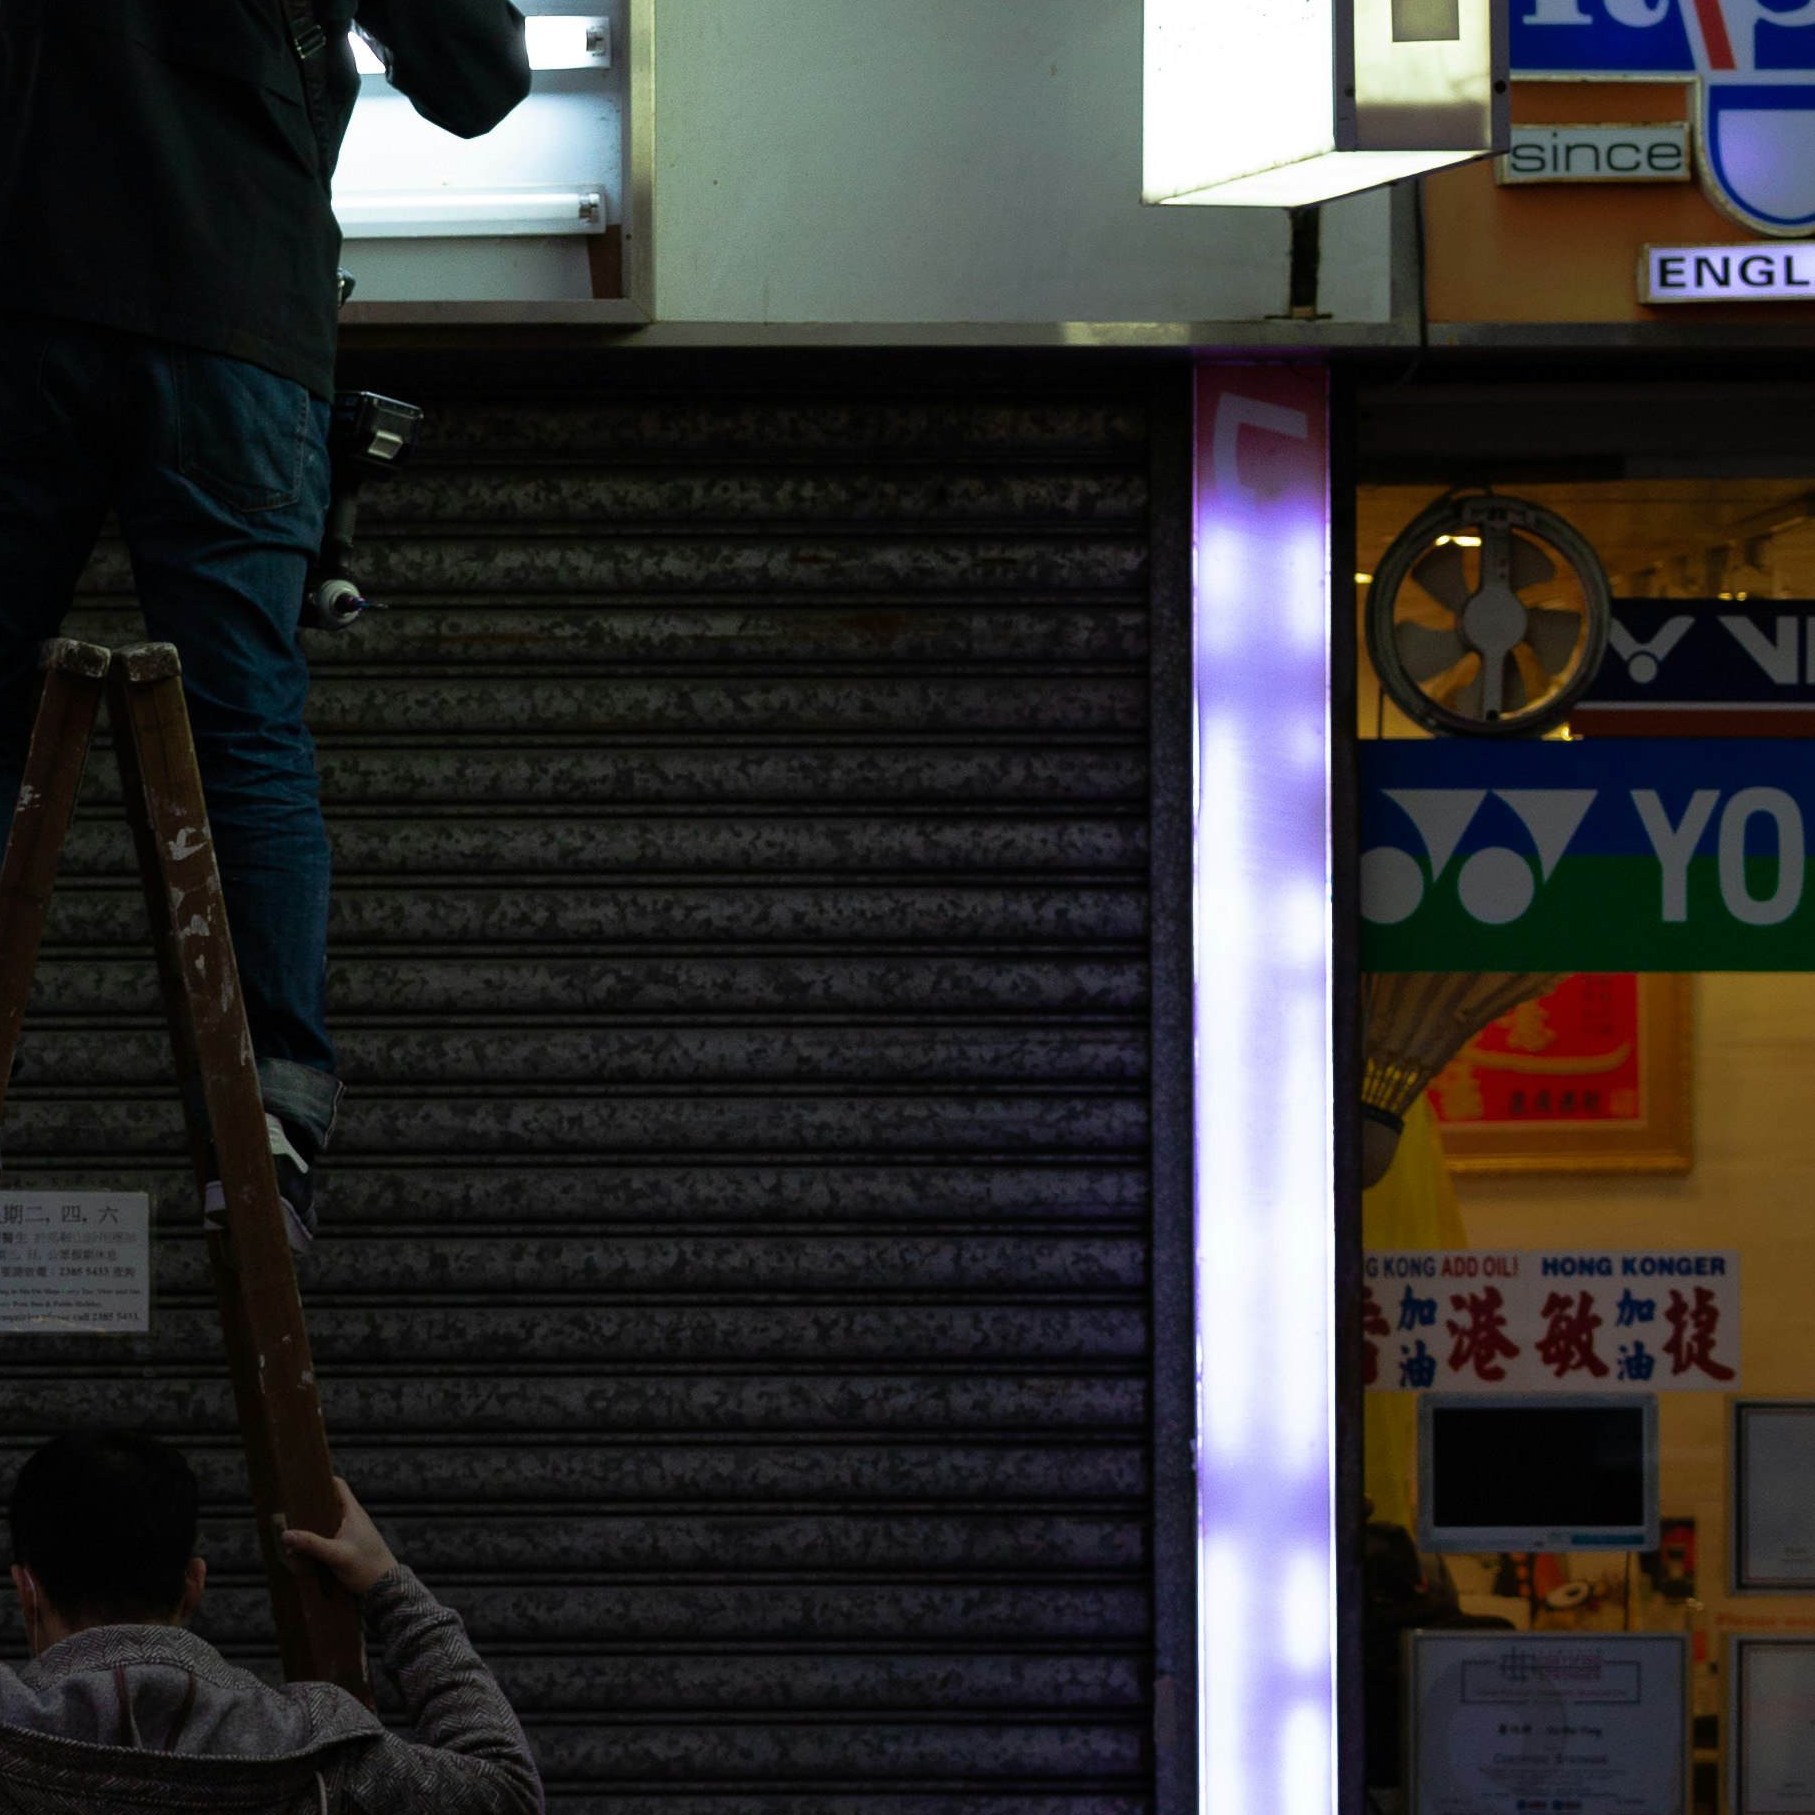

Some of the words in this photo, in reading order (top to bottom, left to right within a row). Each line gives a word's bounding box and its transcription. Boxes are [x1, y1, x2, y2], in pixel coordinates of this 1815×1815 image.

[1511, 131, 1683, 173] since
[1658, 255, 1810, 289] ENGL
[1629, 786, 1805, 926] YO
[98, 1205, 120, 1224] 六
[1383, 1256, 1437, 1278] KONG
[1441, 1256, 1477, 1278] ADD
[1483, 1256, 1520, 1278] OIL!
[1541, 1256, 1614, 1277] HONG
[1622, 1256, 1726, 1277] KONGER
[1445, 1286, 1521, 1382] 港
